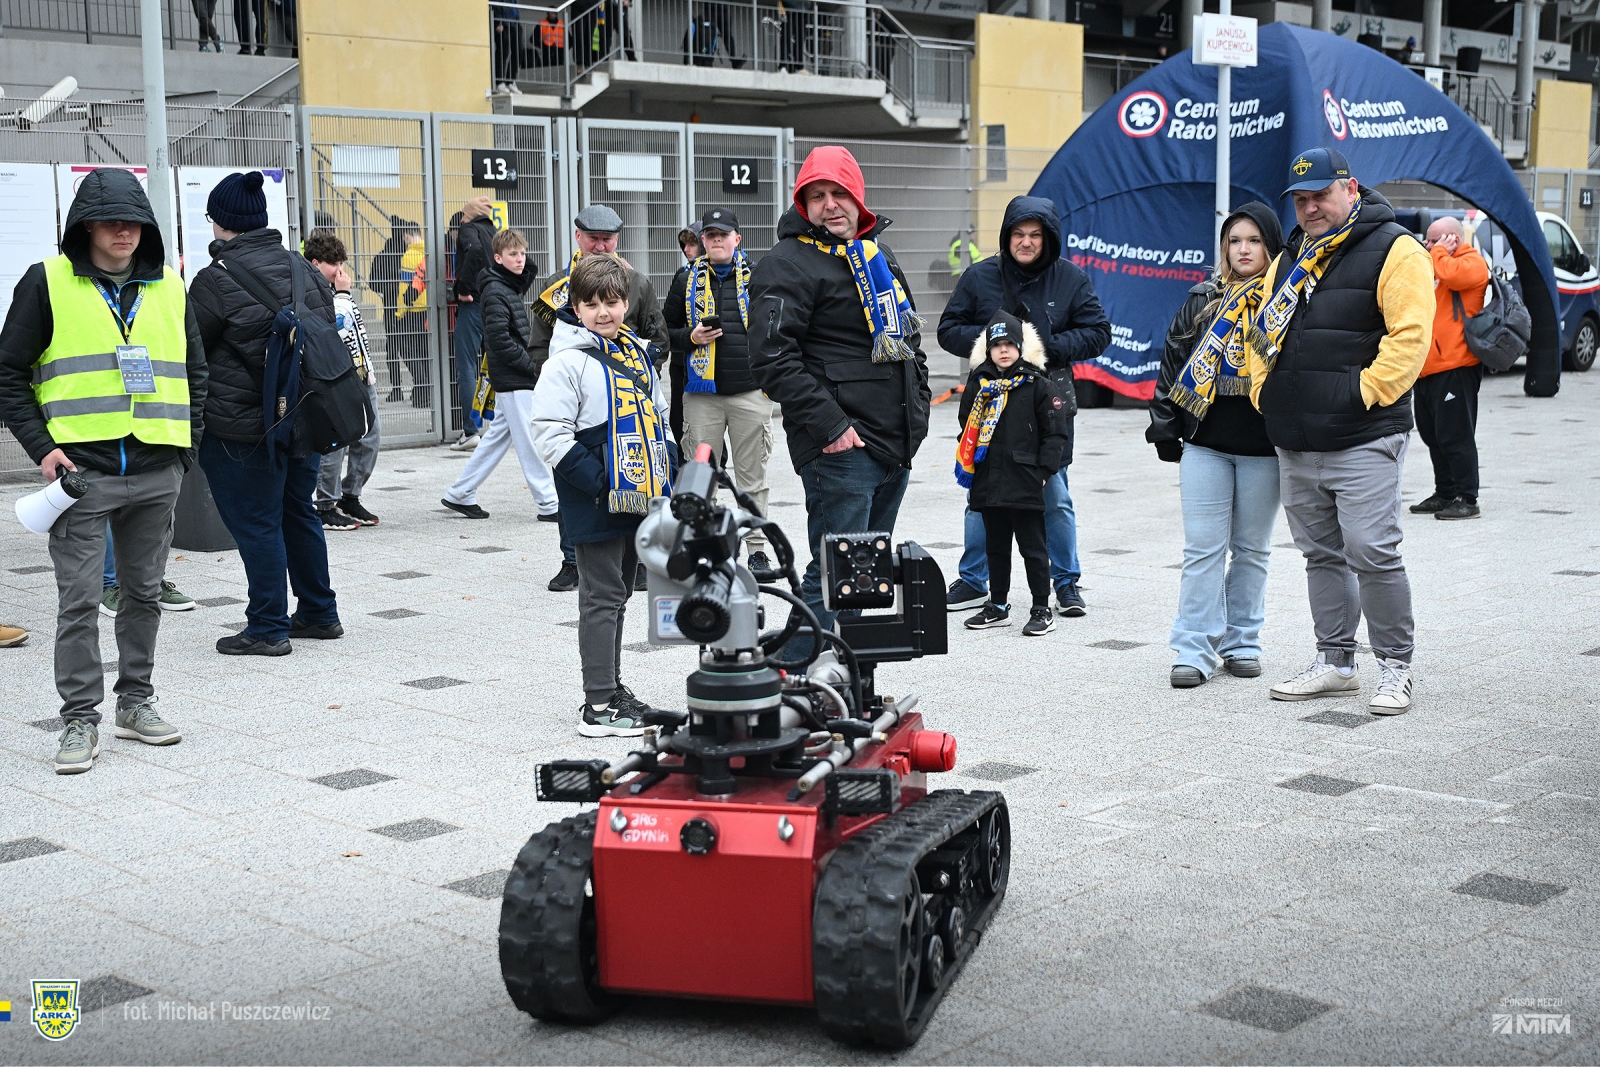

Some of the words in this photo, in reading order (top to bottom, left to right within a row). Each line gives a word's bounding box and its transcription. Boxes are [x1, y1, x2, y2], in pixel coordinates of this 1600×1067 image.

[1159, 12, 1173, 32] 21
[1215, 27, 1246, 39] JANUSZA
[1207, 39, 1254, 53] KUPCEWICZA
[1340, 98, 1406, 118] Centrum
[1167, 111, 1286, 140] Ratonictwa
[1347, 115, 1449, 139] Ratownictwa
[483, 157, 508, 180] 13
[731, 164, 751, 185] 12
[1582, 191, 1592, 205] 11
[1067, 233, 1170, 265] Defibrylatory
[1171, 249, 1205, 264] AED
[1072, 254, 1118, 274] sprzęt
[1121, 262, 1207, 284] ratowniczy
[685, 300, 693, 328] GDYN
[626, 461, 645, 469] ARK
[630, 812, 658, 827] JRG
